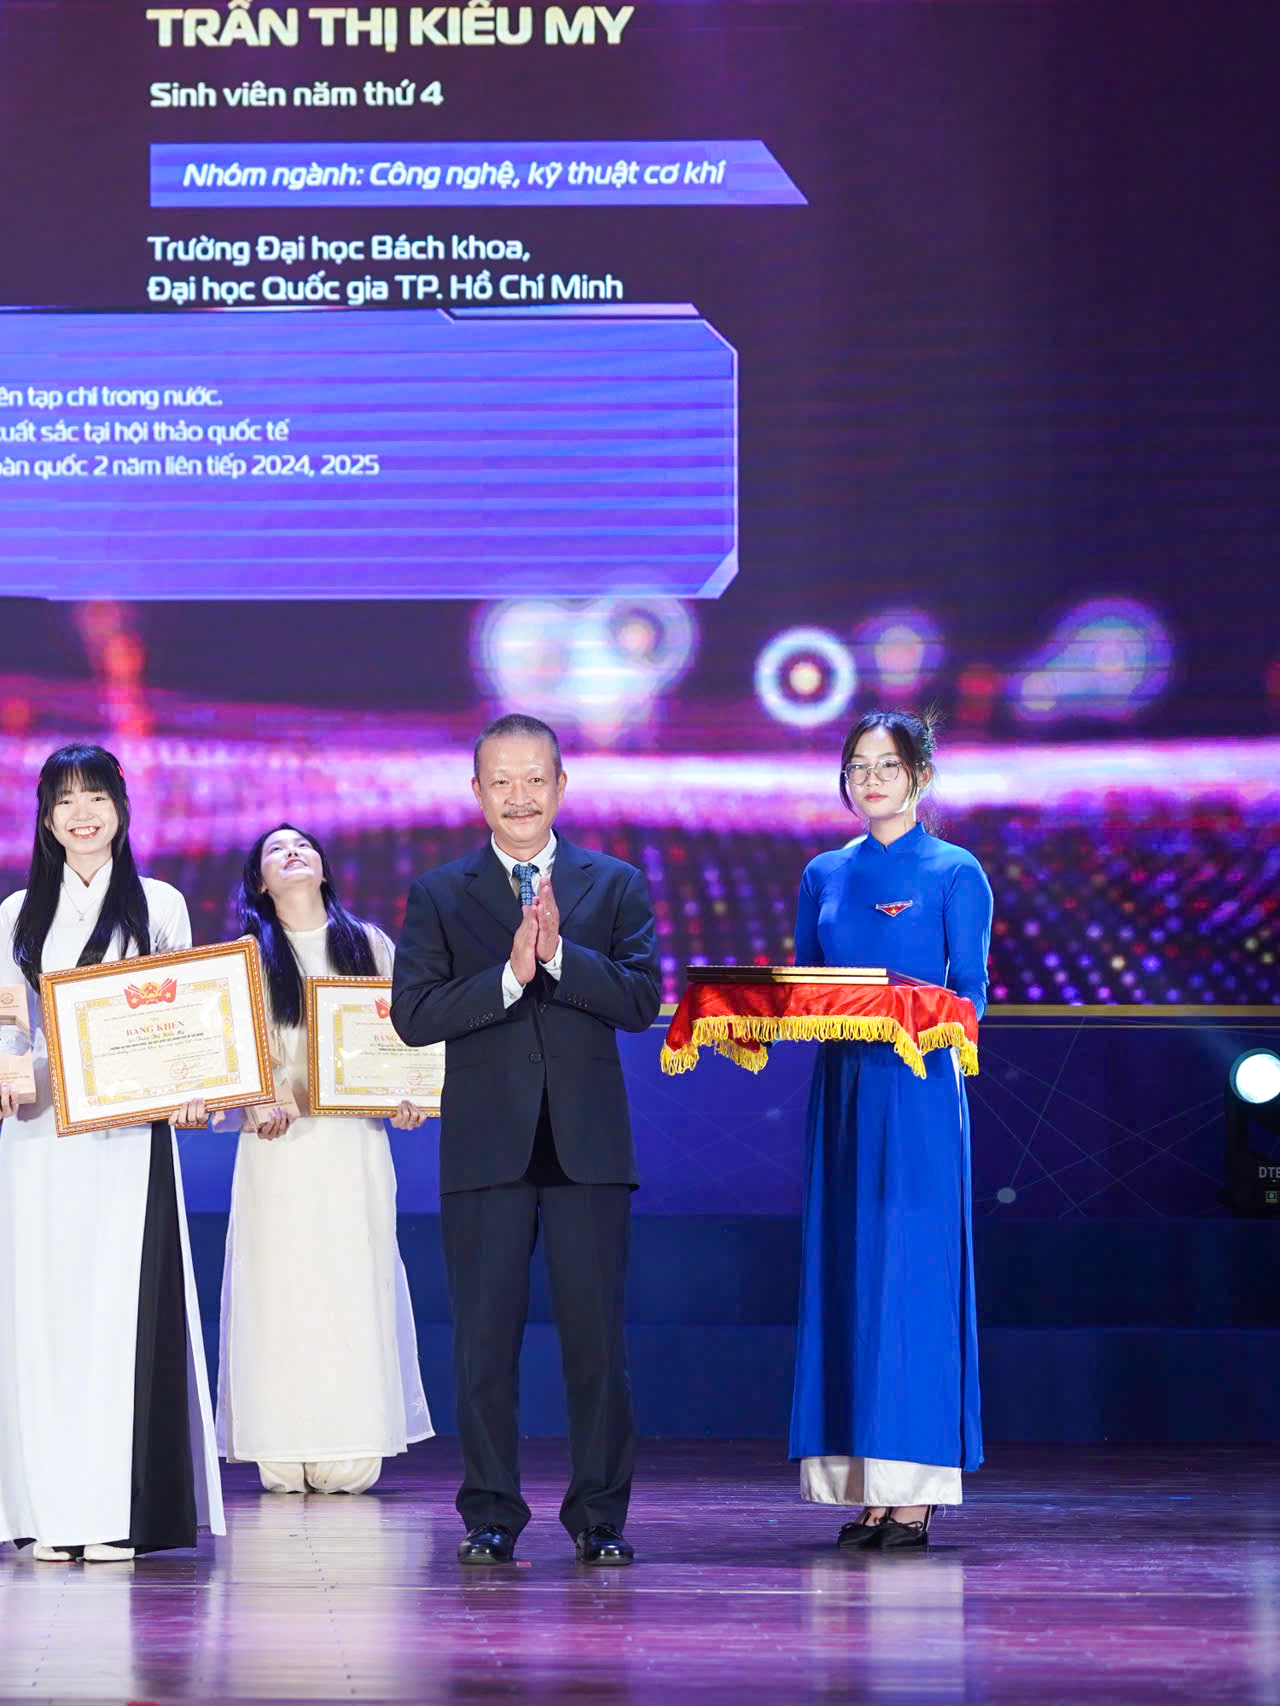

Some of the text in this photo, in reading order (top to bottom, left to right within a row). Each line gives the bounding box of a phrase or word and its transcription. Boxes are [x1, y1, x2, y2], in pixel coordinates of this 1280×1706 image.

[309, 8, 397, 52] THỊ
[545, 6, 634, 44] MY
[150, 79, 443, 107] Sinh viên năm thứ 4
[183, 160, 726, 190] Nhóm ngành: Công nghệ, kỹ thuật cơ khí
[147, 234, 530, 266] Trường Đại học Bách khoa,
[147, 270, 623, 304] Đại học Quốc gia TP. Hồ Chí Minh
[26, 387, 63, 410] tạp
[66, 386, 98, 407] chí
[101, 387, 160, 410] trong
[163, 386, 223, 407] nước.
[41, 420, 80, 442] sắc
[83, 421, 110, 445] tại
[114, 421, 148, 445] hội
[152, 419, 203, 442] thảo
[207, 418, 262, 446] quốc
[266, 418, 290, 442] tế
[34, 453, 88, 480] quốc
[93, 455, 109, 477] 2
[113, 457, 161, 476] năm
[165, 455, 202, 476] liên
[206, 453, 247, 479] tiếp
[251, 454, 315, 478] 2024,
[320, 454, 380, 476] 2025
